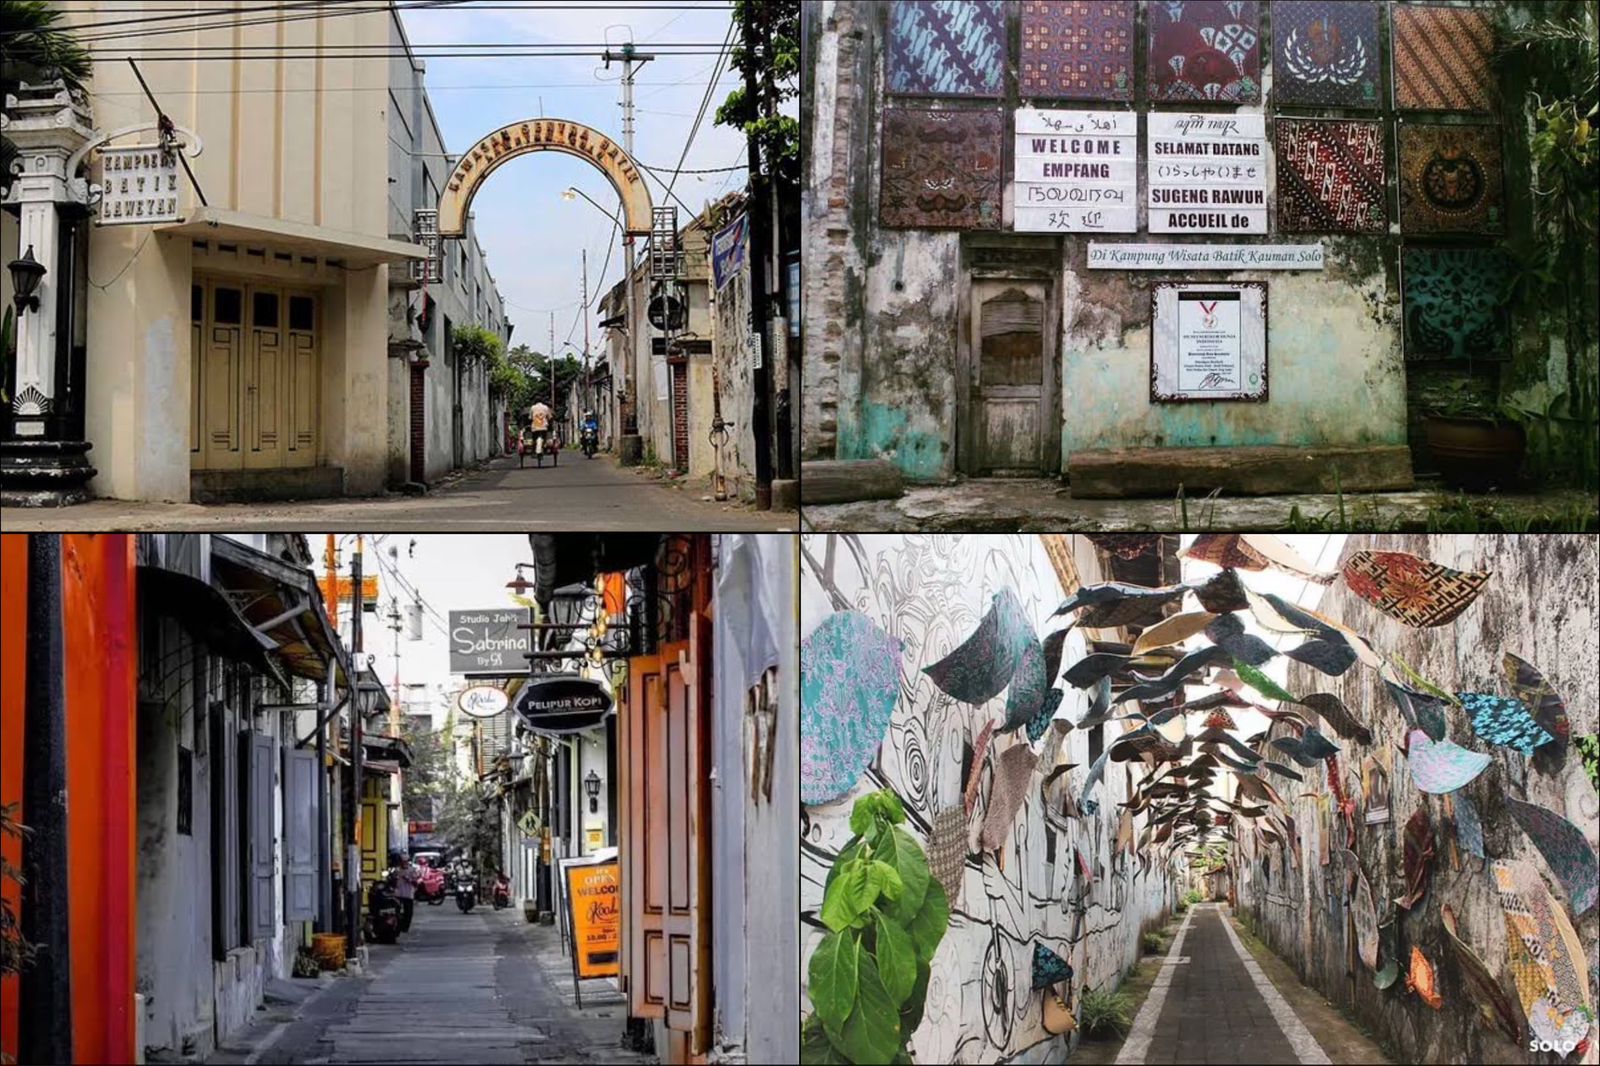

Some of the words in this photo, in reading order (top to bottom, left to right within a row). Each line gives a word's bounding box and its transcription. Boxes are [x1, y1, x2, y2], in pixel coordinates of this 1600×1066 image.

[1031, 139, 1121, 155] WELCOME
[1154, 142, 1210, 155] SELAMAT
[1212, 143, 1260, 156] DATANG
[600, 139, 639, 184] BATIK
[1043, 163, 1110, 178] EMPFANG
[105, 175, 176, 194] BATIK
[1152, 189, 1209, 203] SUGENG
[1212, 190, 1264, 204] RAWUH
[104, 198, 176, 217] LAWEYAN
[1168, 213, 1228, 228] ACCUEIL
[1231, 214, 1249, 228] de
[1090, 249, 1107, 261] Di
[1109, 249, 1166, 264] Kampung
[1168, 248, 1210, 261] Wisata
[1212, 249, 1247, 264] Batik
[1248, 250, 1295, 264] Kauman
[1297, 249, 1322, 262] Solo
[460, 614, 490, 624] Studio
[452, 627, 528, 654] Sabrina
[577, 884, 620, 898] WELCO
